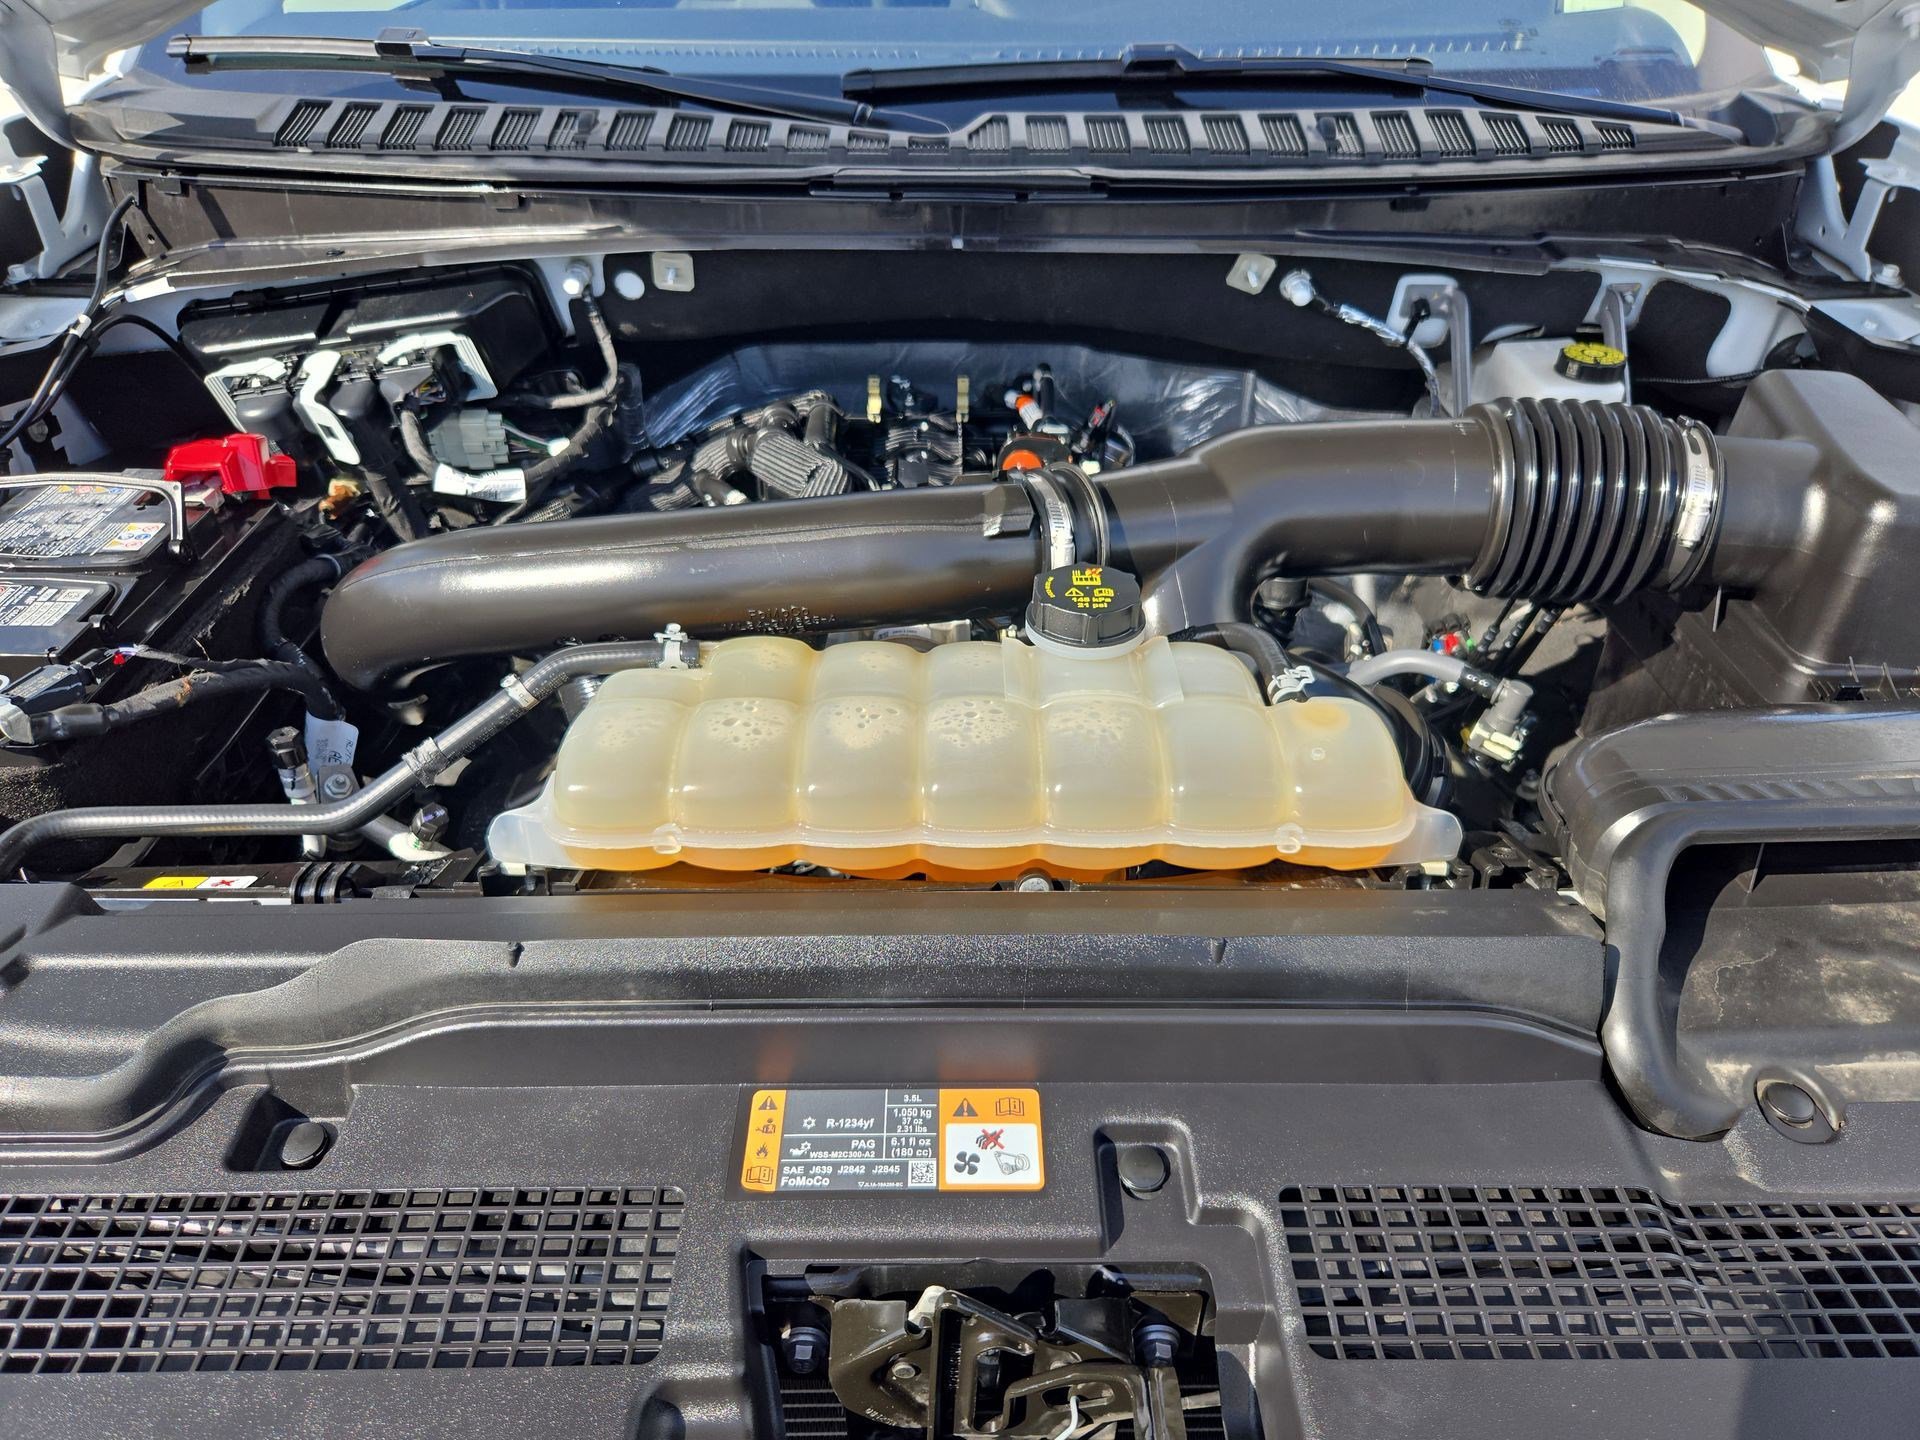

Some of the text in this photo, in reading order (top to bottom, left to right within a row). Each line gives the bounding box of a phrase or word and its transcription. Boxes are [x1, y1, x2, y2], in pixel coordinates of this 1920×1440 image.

[903, 1094, 922, 1103] 3.5L
[893, 1107, 932, 1119] 1.050 kg
[826, 1118, 875, 1129] R-1234yf
[901, 1117, 912, 1125] 37
[896, 1125, 927, 1133] 2.31 lbs
[851, 1139, 876, 1149] PAG
[890, 1136, 931, 1146] 6.1 fl oz
[809, 1150, 876, 1159] WSS-M2C300-A2
[890, 1147, 932, 1158] (180 cc)
[782, 1164, 901, 1175] SAE J639 J2842 J2845
[780, 1175, 830, 1187] FoMoCo
